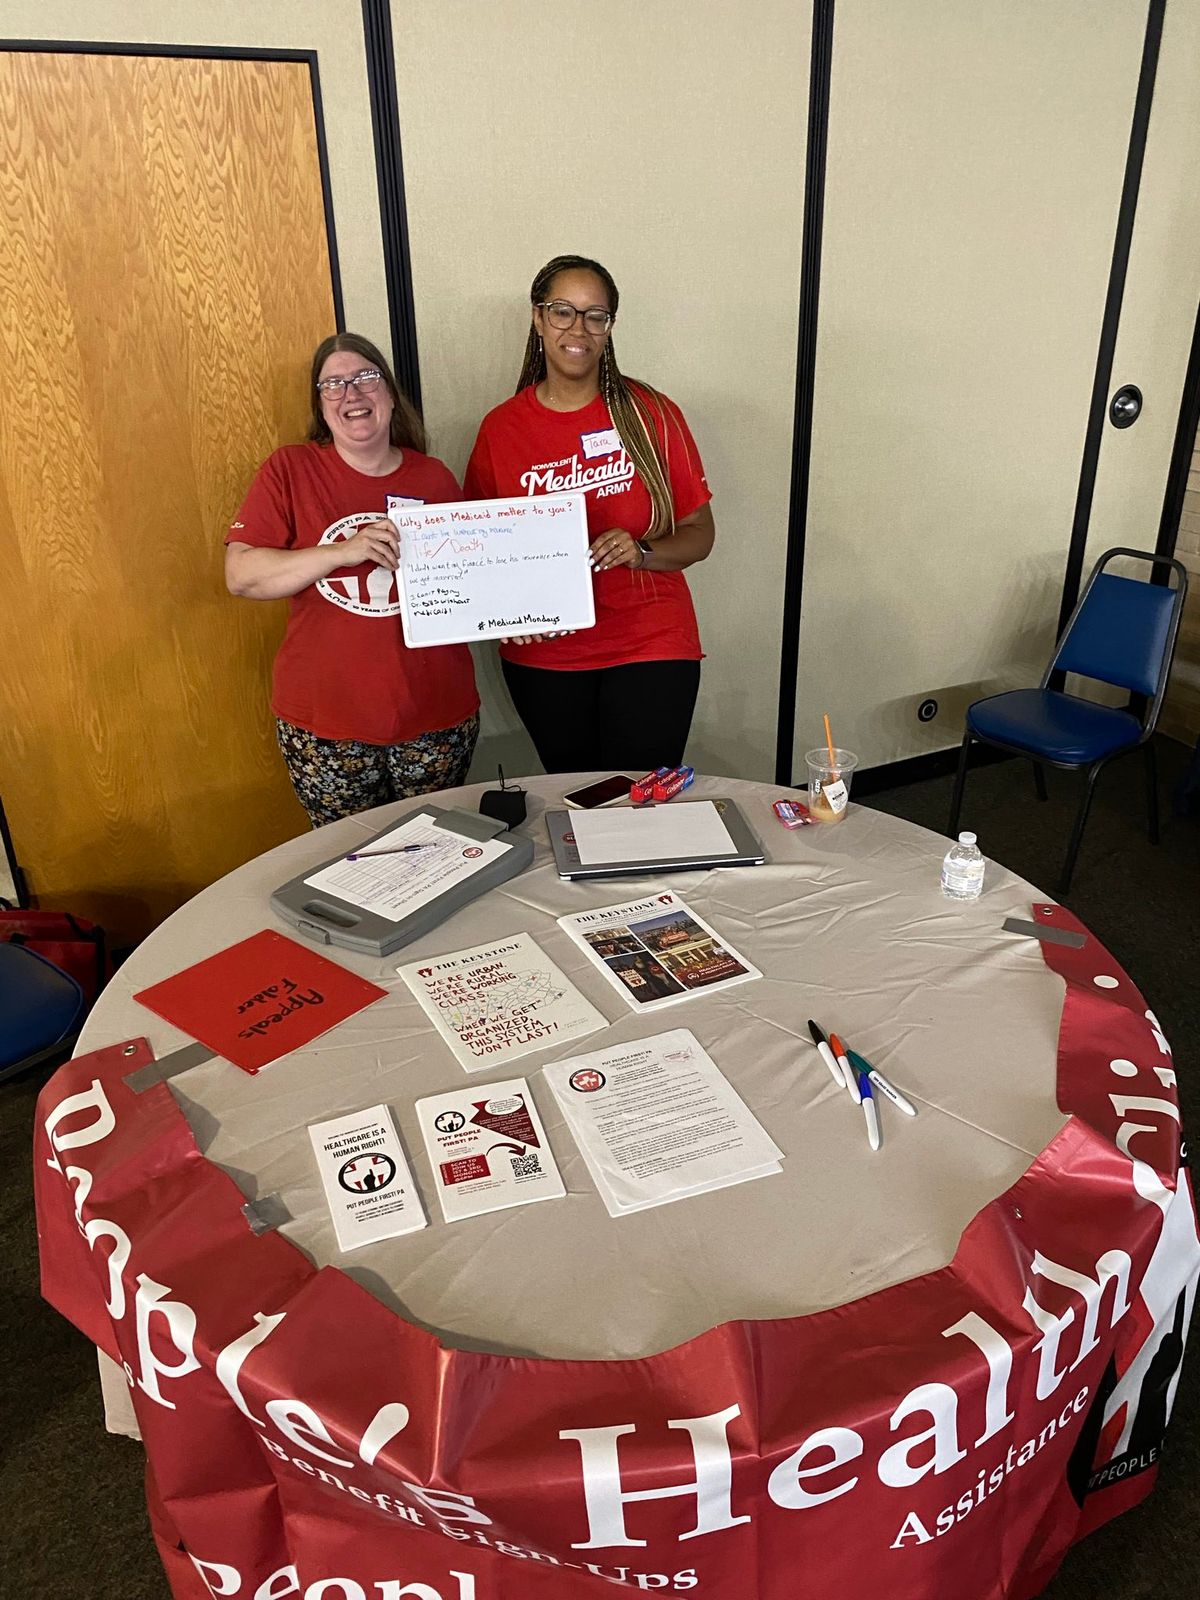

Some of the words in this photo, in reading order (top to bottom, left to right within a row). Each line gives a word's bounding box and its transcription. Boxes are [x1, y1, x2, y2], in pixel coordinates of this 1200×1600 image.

[585, 437, 612, 449] Tara
[520, 449, 635, 497] Medicaid
[532, 457, 572, 471] NONVIOLENT
[596, 481, 633, 499] ARMY
[400, 516, 422, 530] Why
[425, 515, 446, 525] does
[450, 509, 491, 521] Medicaid
[497, 506, 527, 518] matter
[532, 505, 544, 515] to
[548, 501, 573, 517] you?
[574, 914, 599, 923] THE
[599, 901, 657, 919] KEYSTONE
[434, 961, 460, 971] THE
[461, 943, 522, 964] KEYSTONE
[470, 972, 517, 991] WORKING
[238, 988, 325, 1040] Appeals
[490, 1013, 507, 1023] WE
[466, 1036, 493, 1050] THIS
[495, 1019, 544, 1041] SYSTEM
[516, 1021, 559, 1044] LAST!
[324, 1132, 371, 1151] HEALTHCARE
[372, 1129, 380, 1137] IS
[443, 1138, 467, 1147] FIRST!
[454, 1128, 482, 1138] PEOPLE
[333, 1145, 361, 1158] HUMAN
[361, 1137, 386, 1150] RIGHT!
[346, 1202, 358, 1210] PUT
[358, 1195, 378, 1206] PEOPLE
[397, 1188, 405, 1196] PA
[559, 1249, 1132, 1550] Health
[889, 1385, 1089, 1550] Assistance
[1098, 1447, 1157, 1485] PEOPLE
[260, 1434, 426, 1527] Benefit
[438, 1522, 699, 1591] Sign-Ups
